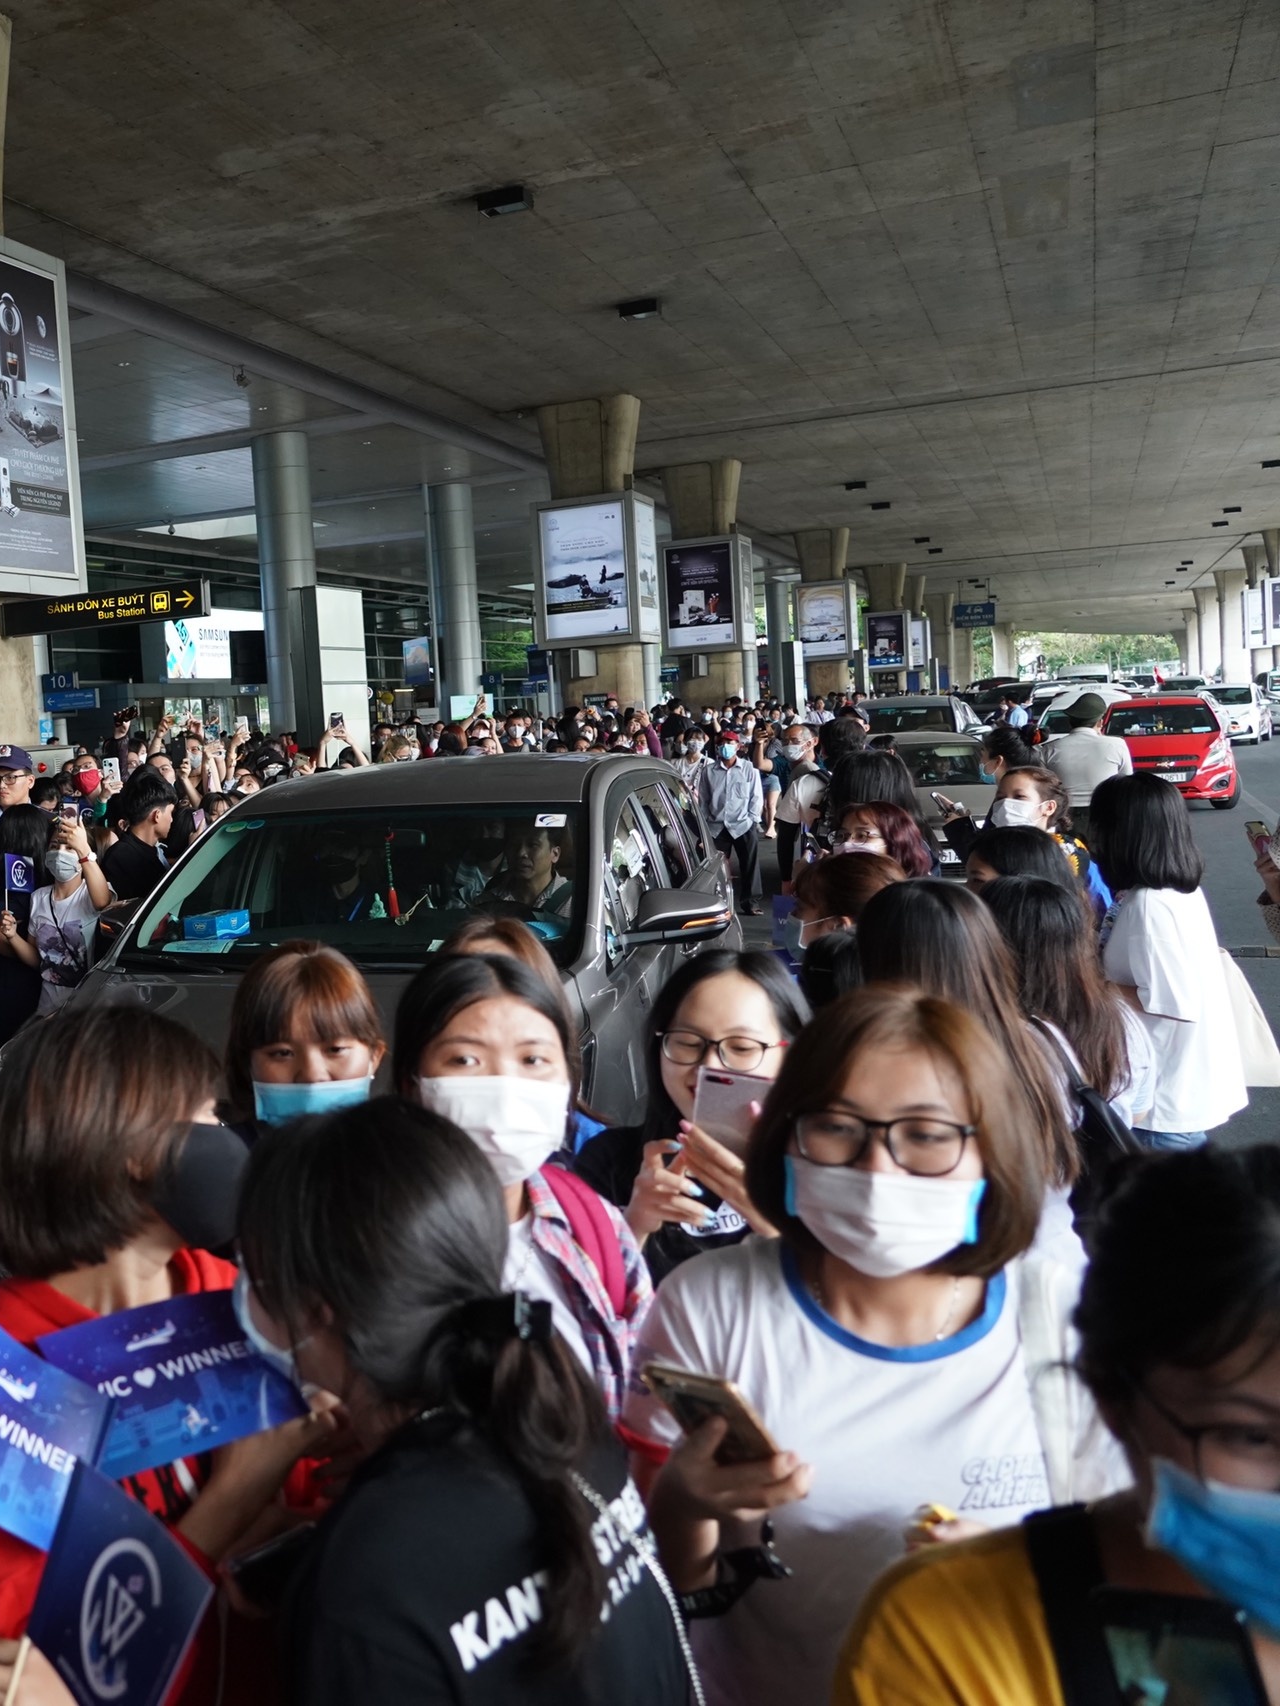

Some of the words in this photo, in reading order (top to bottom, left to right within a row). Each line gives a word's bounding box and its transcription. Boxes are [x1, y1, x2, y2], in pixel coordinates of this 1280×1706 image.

[77, 598, 100, 611] ĐÓN
[101, 597, 116, 608] XE
[117, 593, 145, 606] BUÝT
[98, 610, 114, 619] Bus
[116, 607, 146, 617] Station
[199, 628, 229, 641] SAMSUN
[50, 675, 66, 689] 10
[488, 675, 495, 683] 8
[98, 1376, 133, 1400] IC
